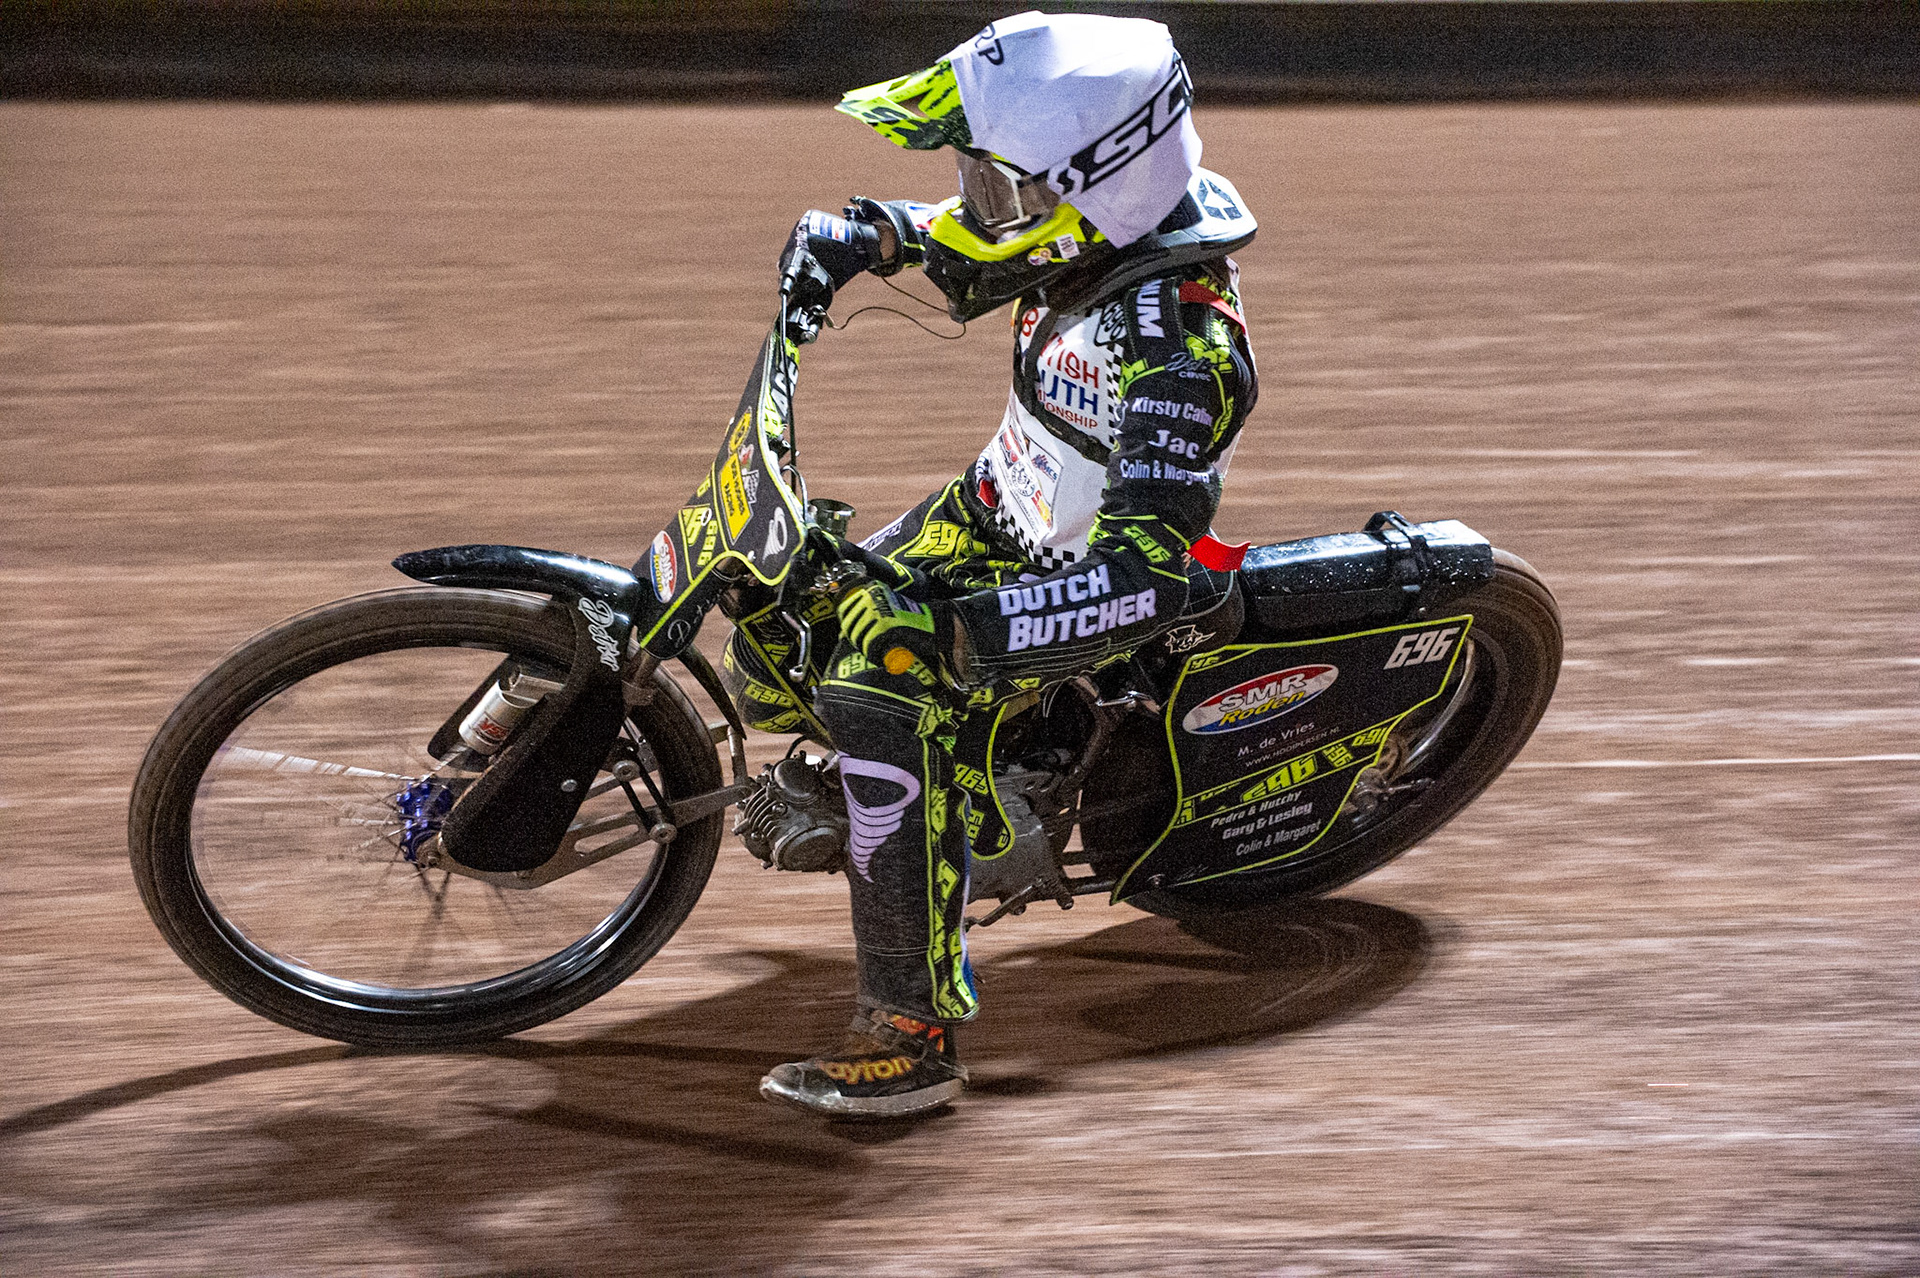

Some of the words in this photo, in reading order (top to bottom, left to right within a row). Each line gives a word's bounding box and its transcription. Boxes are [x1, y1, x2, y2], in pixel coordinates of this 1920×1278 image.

[1132, 397, 1179, 420] Kirsty
[1147, 429, 1200, 460] Jac
[1119, 458, 1150, 479] Colin
[1153, 459, 1165, 479] &
[998, 563, 1112, 616] DUTCH
[1007, 588, 1157, 652] BUTCHER
[1384, 627, 1461, 670] 696
[1218, 672, 1308, 713] SMR
[1219, 691, 1306, 726] Roden
[1237, 747, 1254, 757] M.
[1259, 737, 1275, 748] de
[1281, 722, 1316, 740] Vries
[1211, 812, 1245, 829] Pedro
[1222, 823, 1254, 840] Gary
[1256, 817, 1267, 831] &
[1268, 802, 1314, 826] Lesley
[1236, 839, 1262, 857] Colin
[1264, 834, 1272, 847] &
[1273, 819, 1321, 844] Margaret
